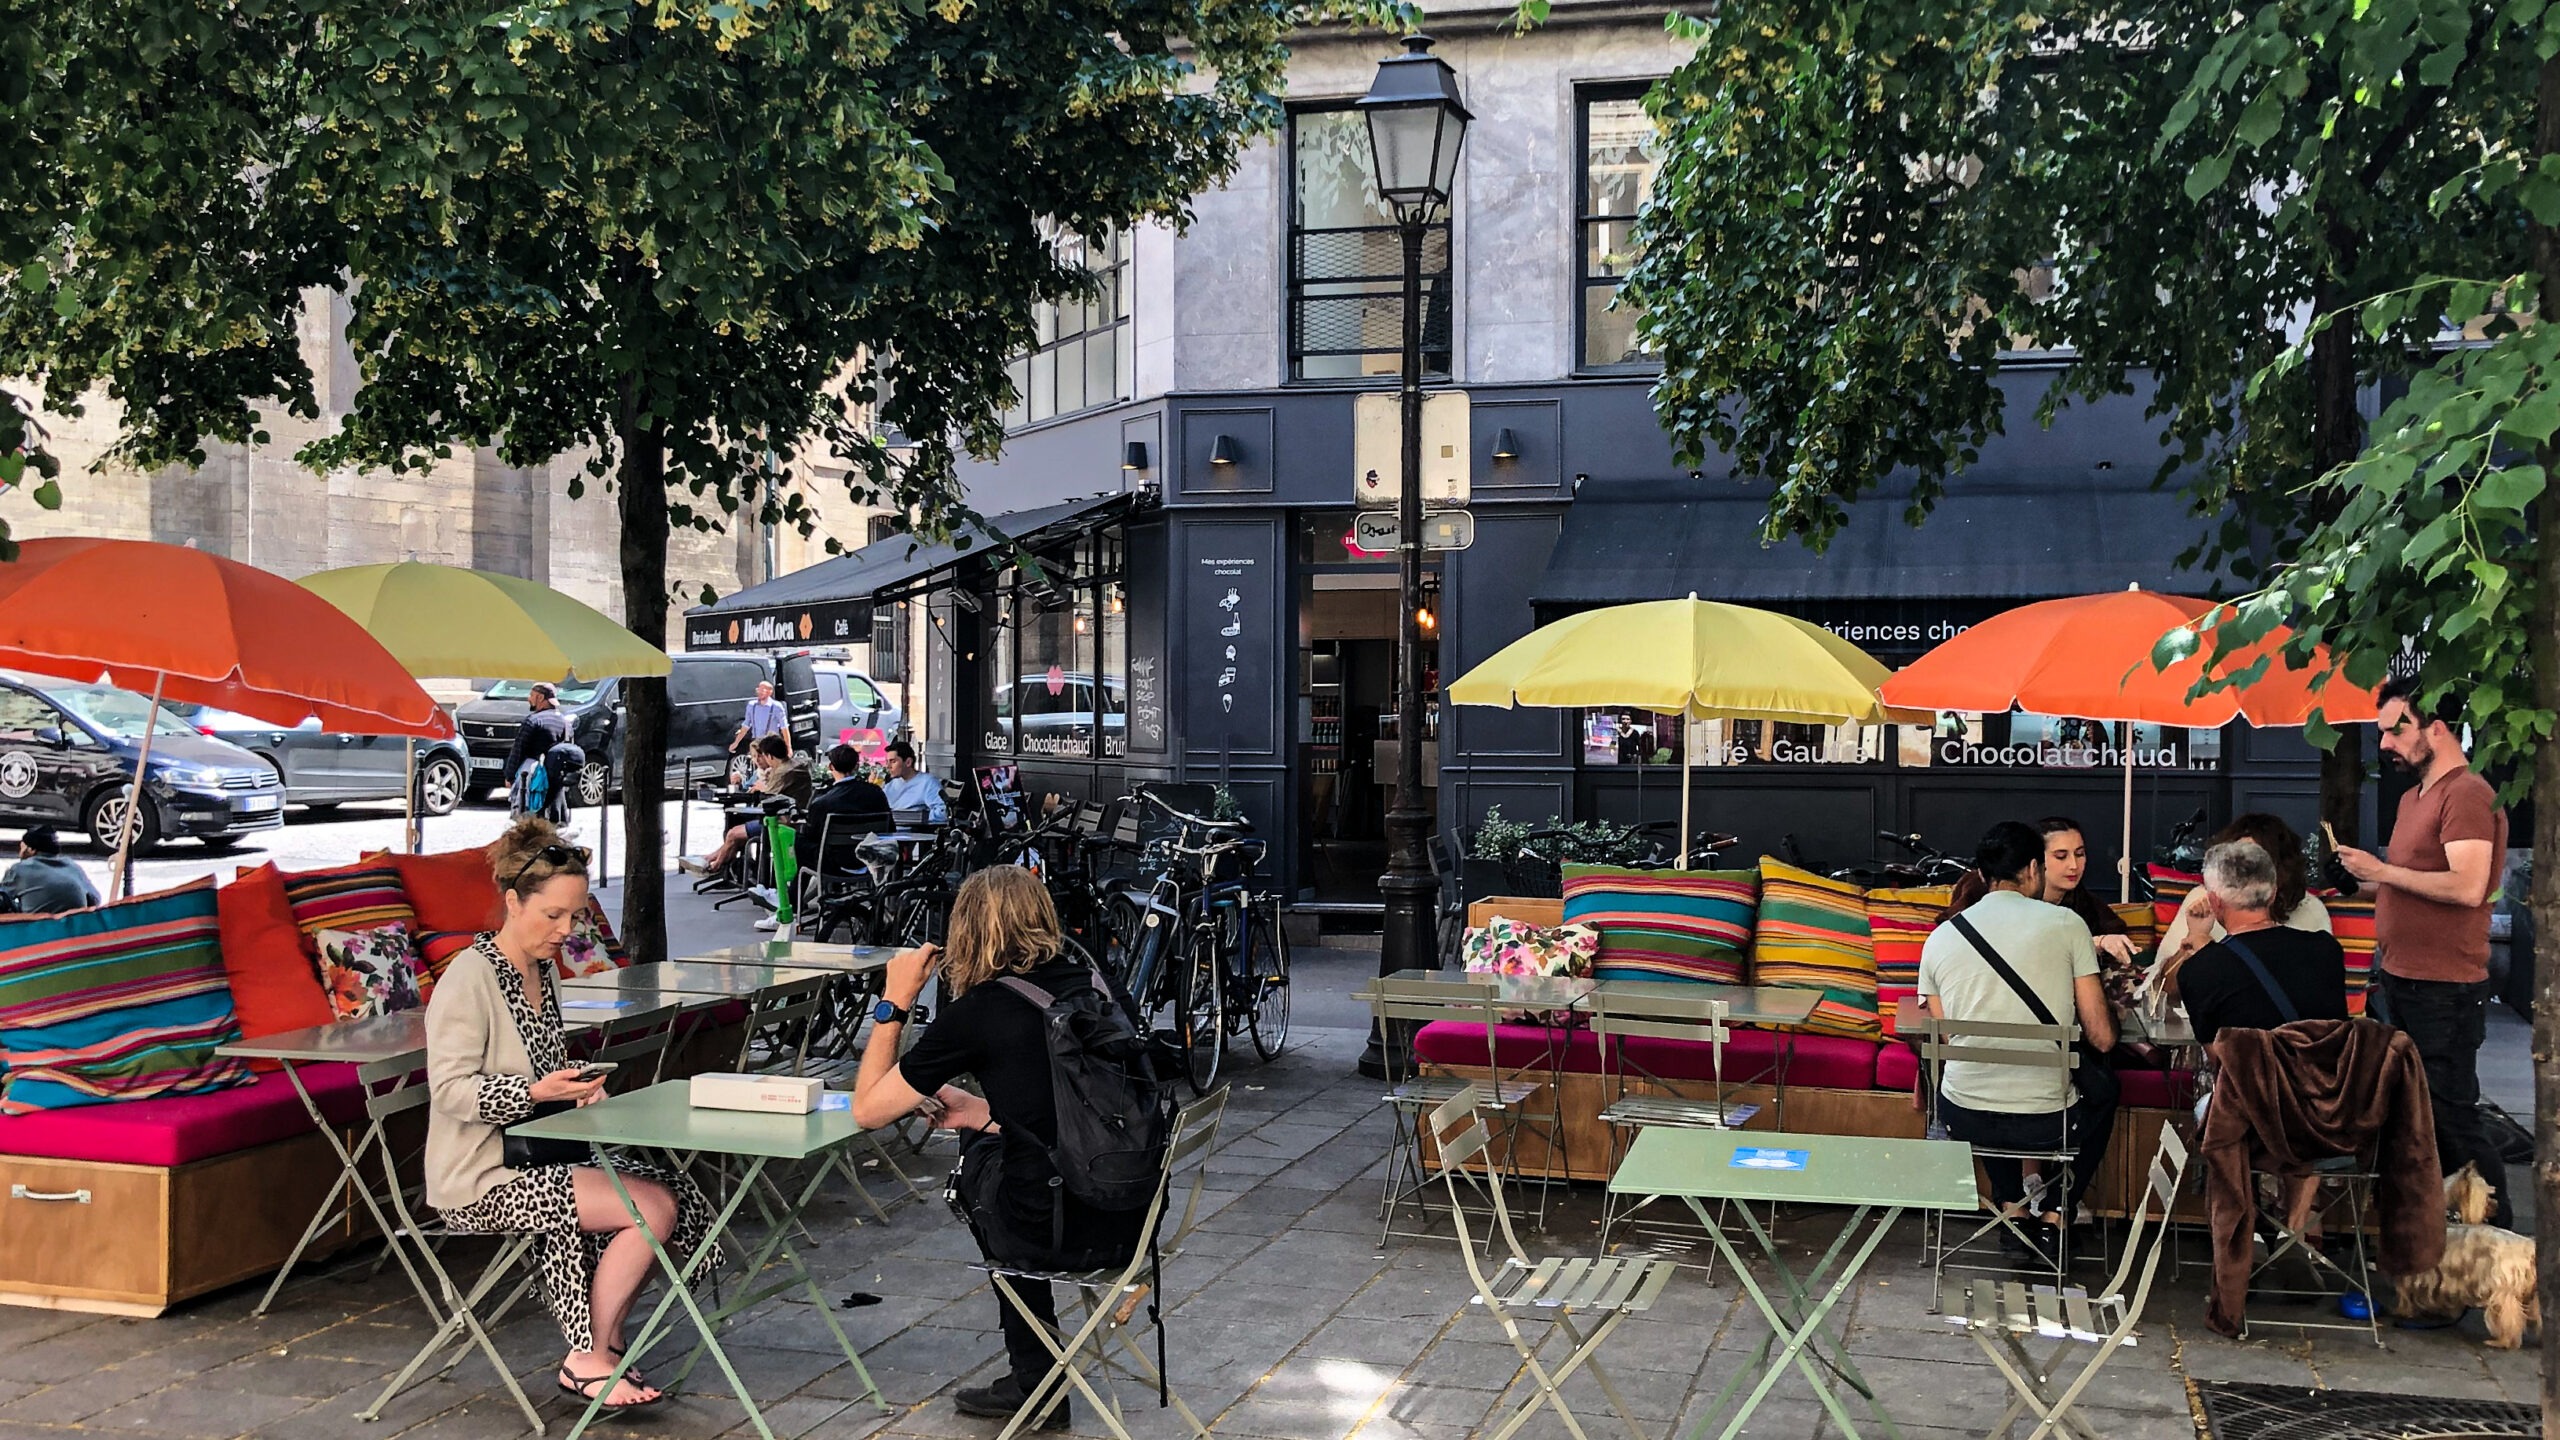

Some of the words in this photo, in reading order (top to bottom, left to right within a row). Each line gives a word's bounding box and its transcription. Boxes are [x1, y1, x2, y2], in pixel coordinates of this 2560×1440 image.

[704, 629, 722, 645] chocolat
[834, 619, 849, 636] Café
[985, 731, 1008, 750] Glace
[1022, 733, 1061, 753] Chocolat
[1062, 734, 1090, 755] chaud
[1772, 738, 1868, 764] Gaue
[1940, 740, 2074, 766] Chocolat
[2082, 742, 2177, 767] chaud
